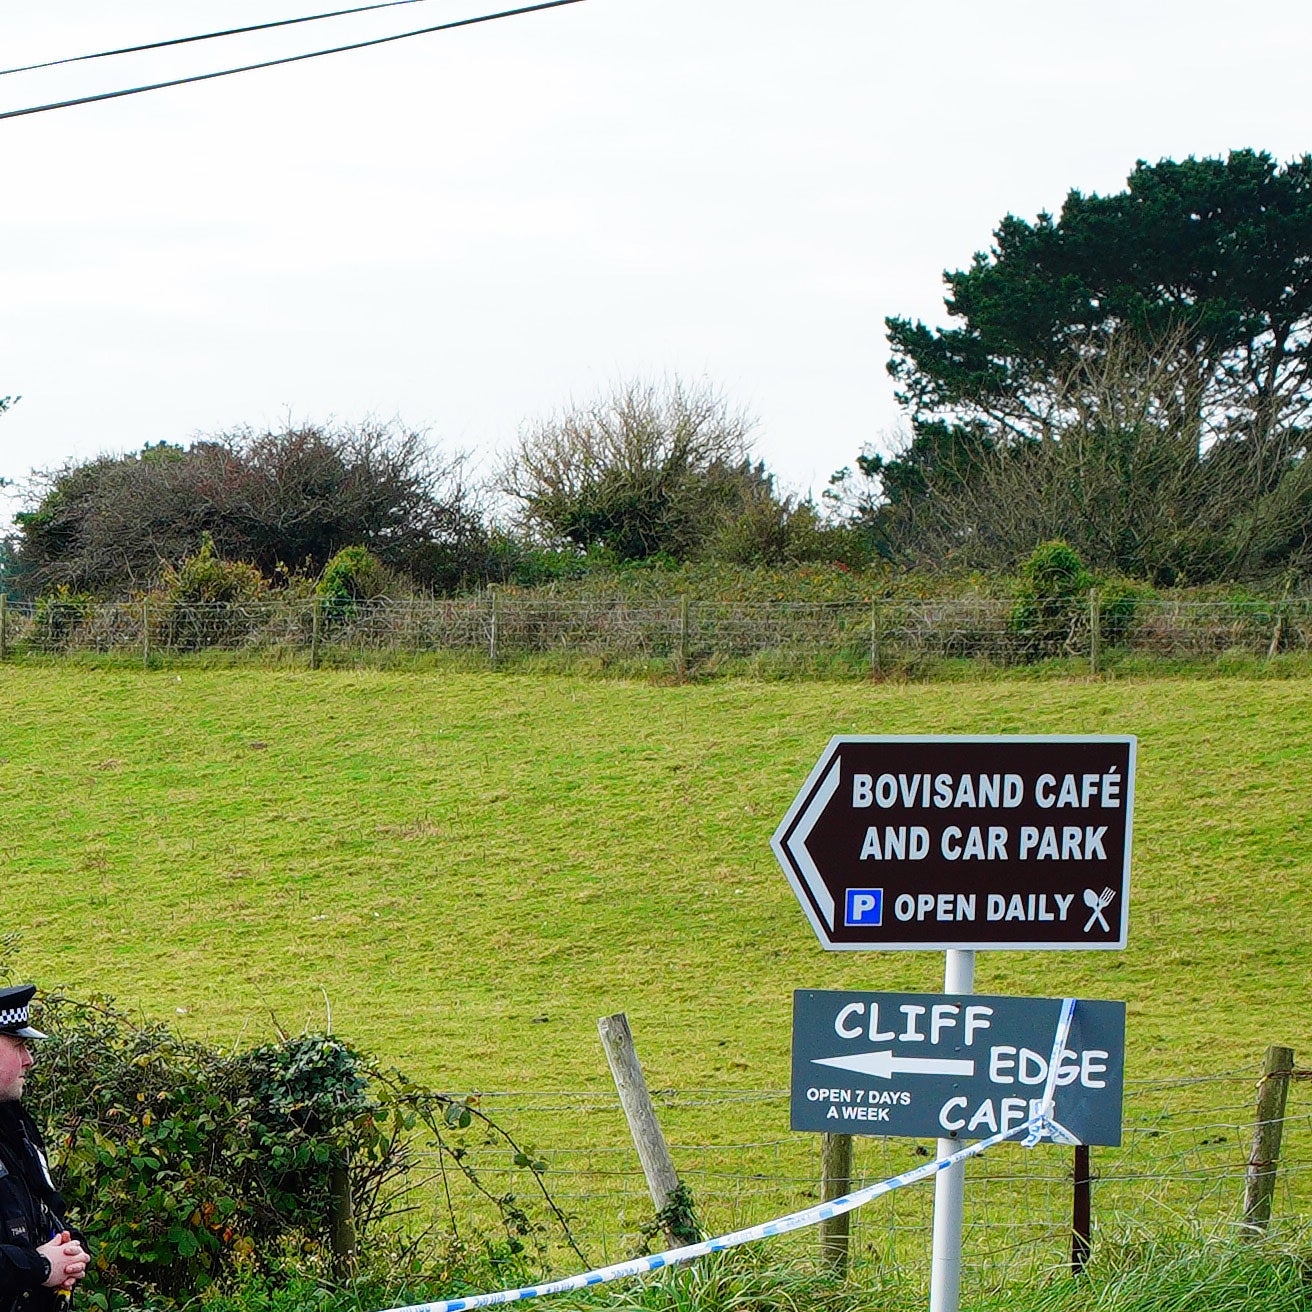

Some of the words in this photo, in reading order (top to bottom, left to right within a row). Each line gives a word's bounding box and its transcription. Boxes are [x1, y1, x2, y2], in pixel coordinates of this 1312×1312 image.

[851, 773, 1024, 808] BOVISAND
[1035, 765, 1122, 809] CAFÉ
[859, 825, 930, 861] AND
[941, 825, 1009, 861] CAR
[1019, 825, 1109, 861] PARK
[852, 895, 876, 921] P
[894, 893, 976, 922] OPEN
[986, 893, 1075, 922] DAILY
[834, 1001, 995, 1046] CLIFF
[806, 1087, 852, 1103] OPEN
[855, 1088, 866, 1104] 7
[868, 1089, 912, 1106] DAYS
[826, 1105, 839, 1119] A
[839, 1106, 891, 1122] WEEK
